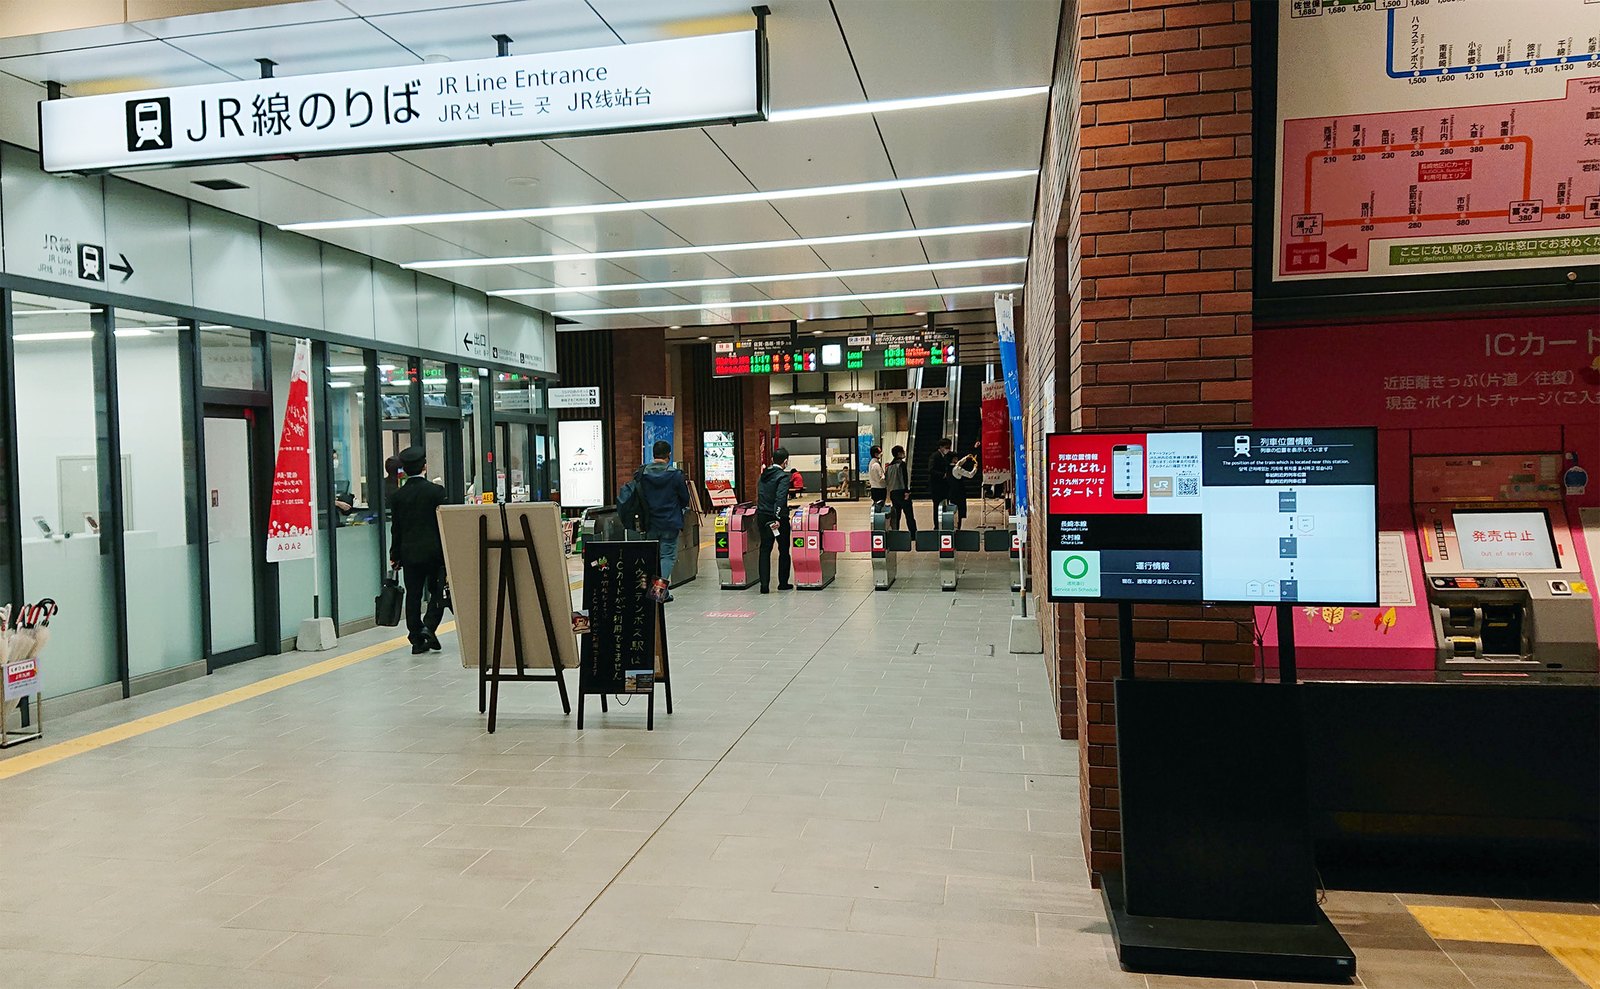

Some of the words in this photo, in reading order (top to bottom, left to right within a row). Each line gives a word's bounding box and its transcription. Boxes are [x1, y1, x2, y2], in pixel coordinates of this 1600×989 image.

[1410, 16, 1420, 69] ハウステンボス
[1524, 67, 1543, 75] 1,130
[1554, 64, 1574, 72] 1,130
[1465, 72, 1484, 80] 1,310
[1494, 70, 1513, 78] 1,310
[437, 76, 458, 95] JR
[465, 73, 507, 92] Line
[515, 66, 608, 88] Entrance
[568, 86, 651, 111] JR线站台
[187, 79, 421, 142] JR線のりば
[438, 102, 480, 122] JR선
[491, 99, 524, 117] 타는
[534, 96, 551, 115] 곳
[1382, 130, 1389, 144] 高田
[1411, 128, 1418, 143] 長与
[43, 233, 72, 254] JR線
[847, 351, 862, 360] Local
[847, 360, 862, 368] Local
[1260, 437, 1313, 446] 列車位置情報
[1050, 463, 1107, 474] 「どれどれ」
[1154, 480, 1169, 488] JR
[1052, 488, 1103, 497] スタート！
[1472, 530, 1536, 542] 発売中止
[1135, 561, 1170, 570] 運行情報
[629, 558, 646, 665] ハウステンボス駅は
